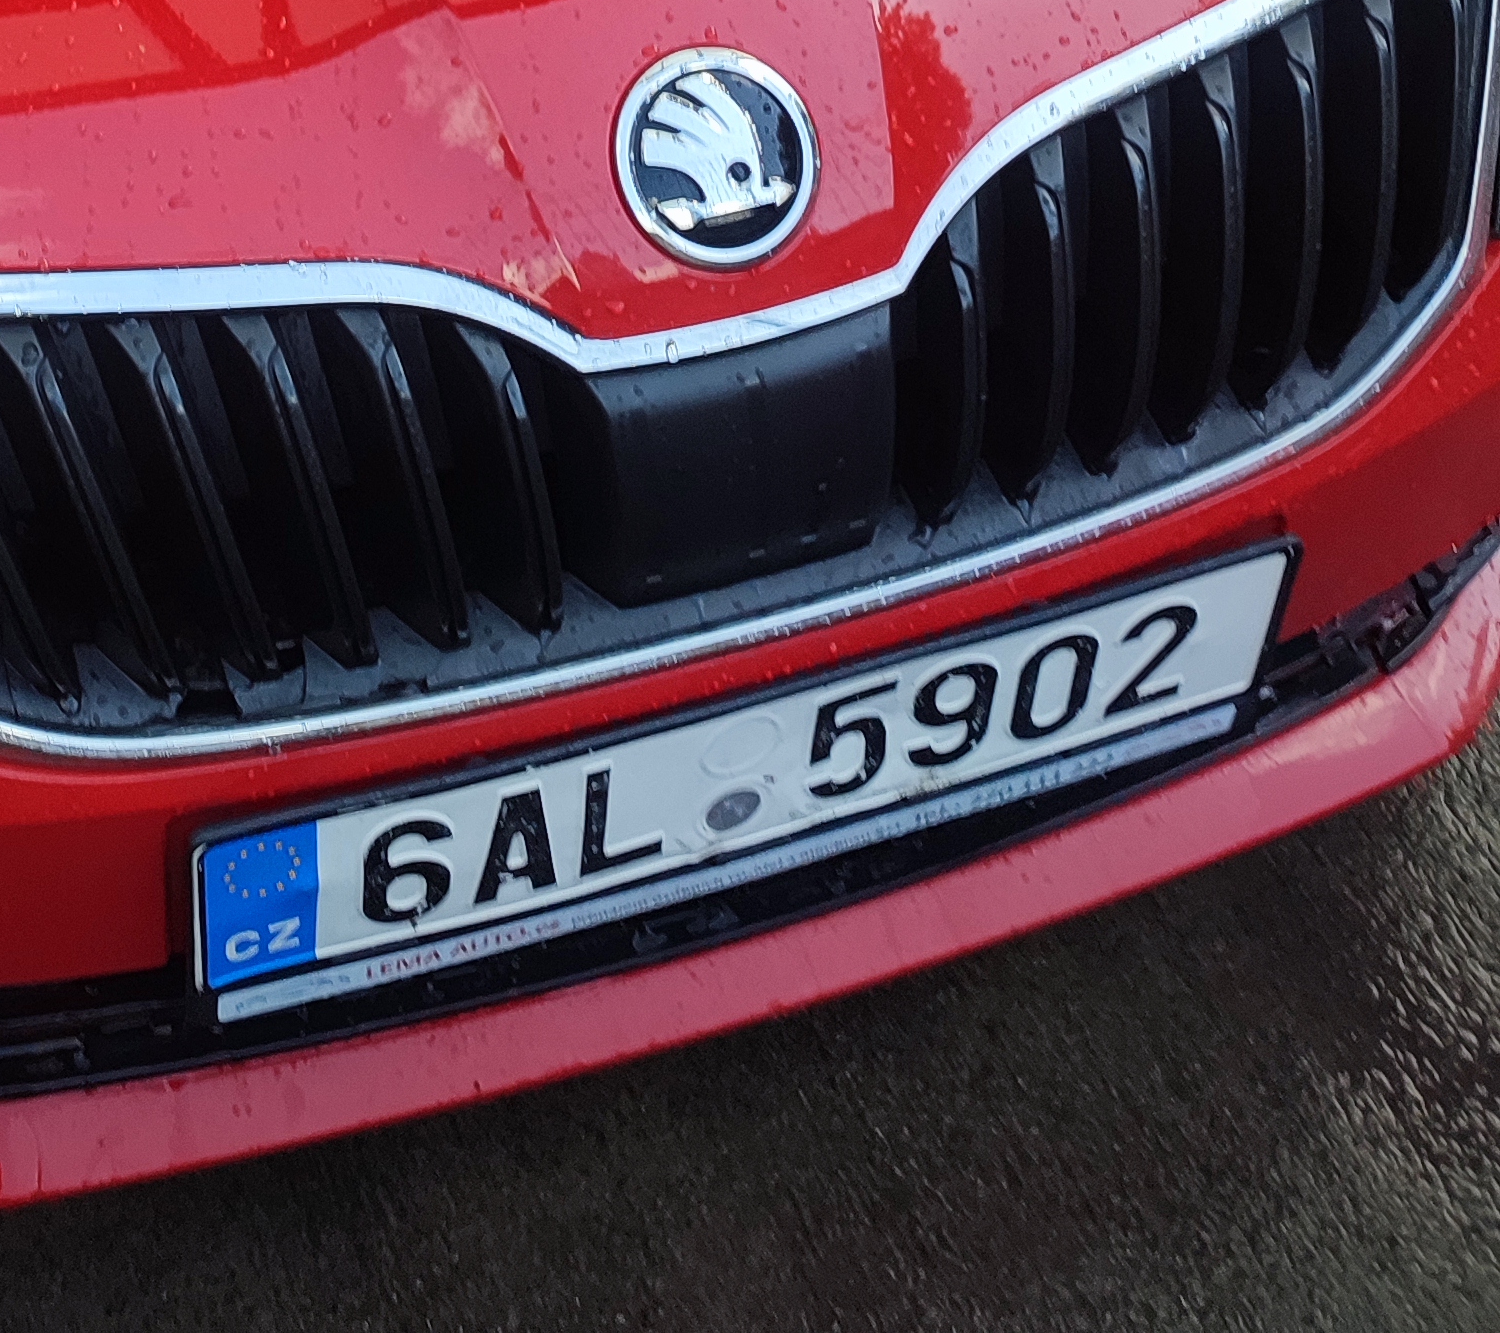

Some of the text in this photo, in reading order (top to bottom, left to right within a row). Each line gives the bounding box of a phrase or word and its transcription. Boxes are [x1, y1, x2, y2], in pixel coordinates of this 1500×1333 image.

[362, 768, 663, 922] 6AL
[808, 604, 1199, 797] 5902
[225, 916, 300, 963] CZ
